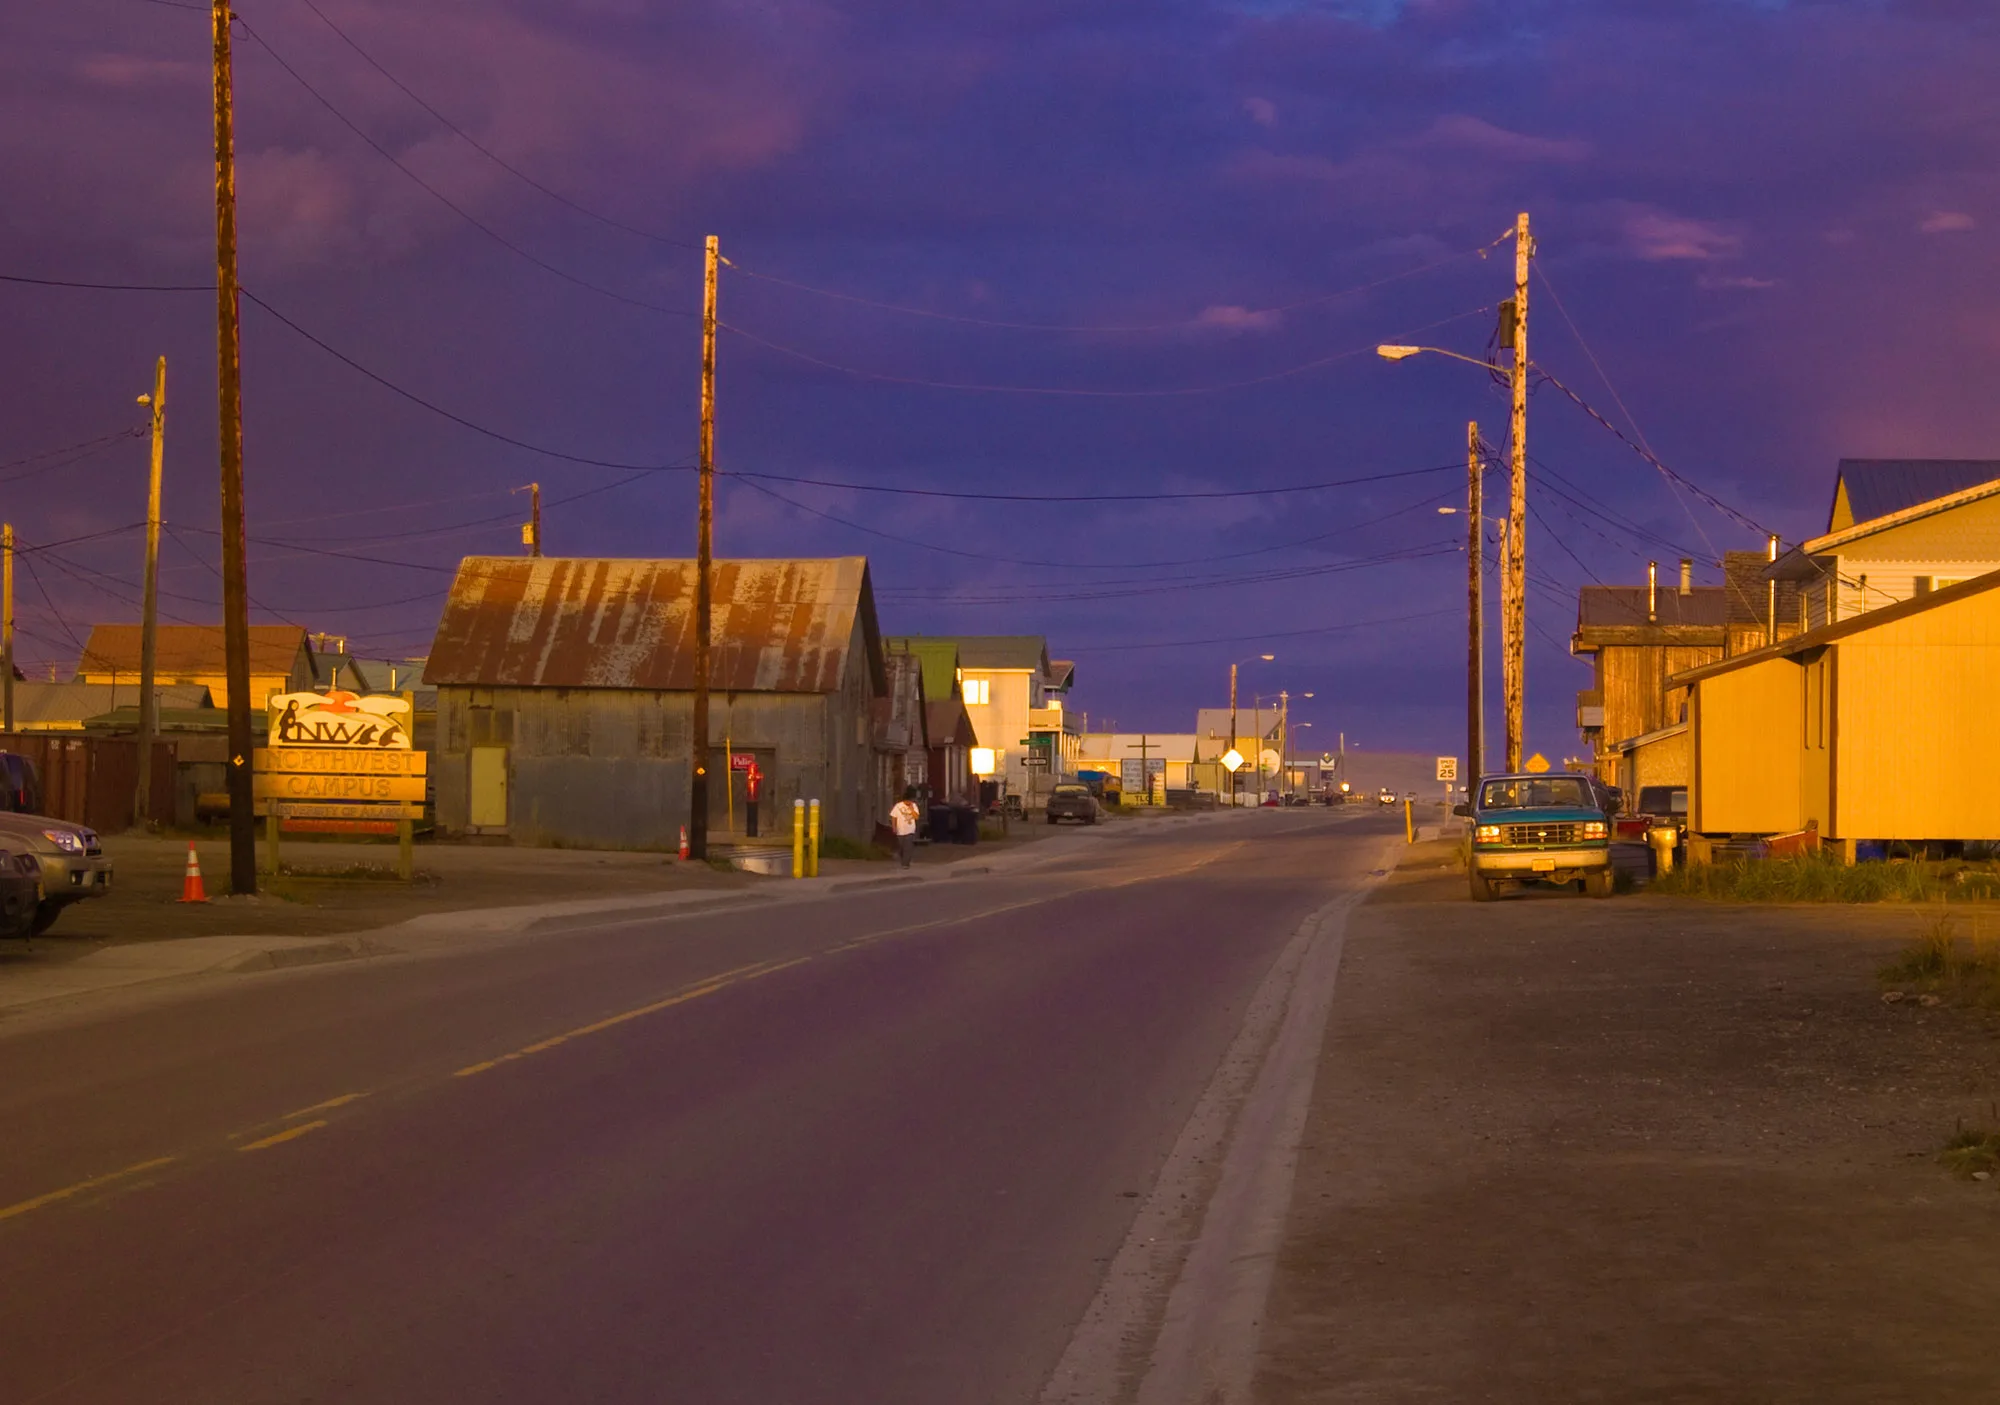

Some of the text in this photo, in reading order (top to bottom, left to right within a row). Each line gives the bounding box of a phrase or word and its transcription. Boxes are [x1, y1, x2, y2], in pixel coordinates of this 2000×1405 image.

[265, 750, 415, 772] NORTHWEST
[1439, 769, 1455, 778] 25
[287, 777, 392, 797] CAMPUS
